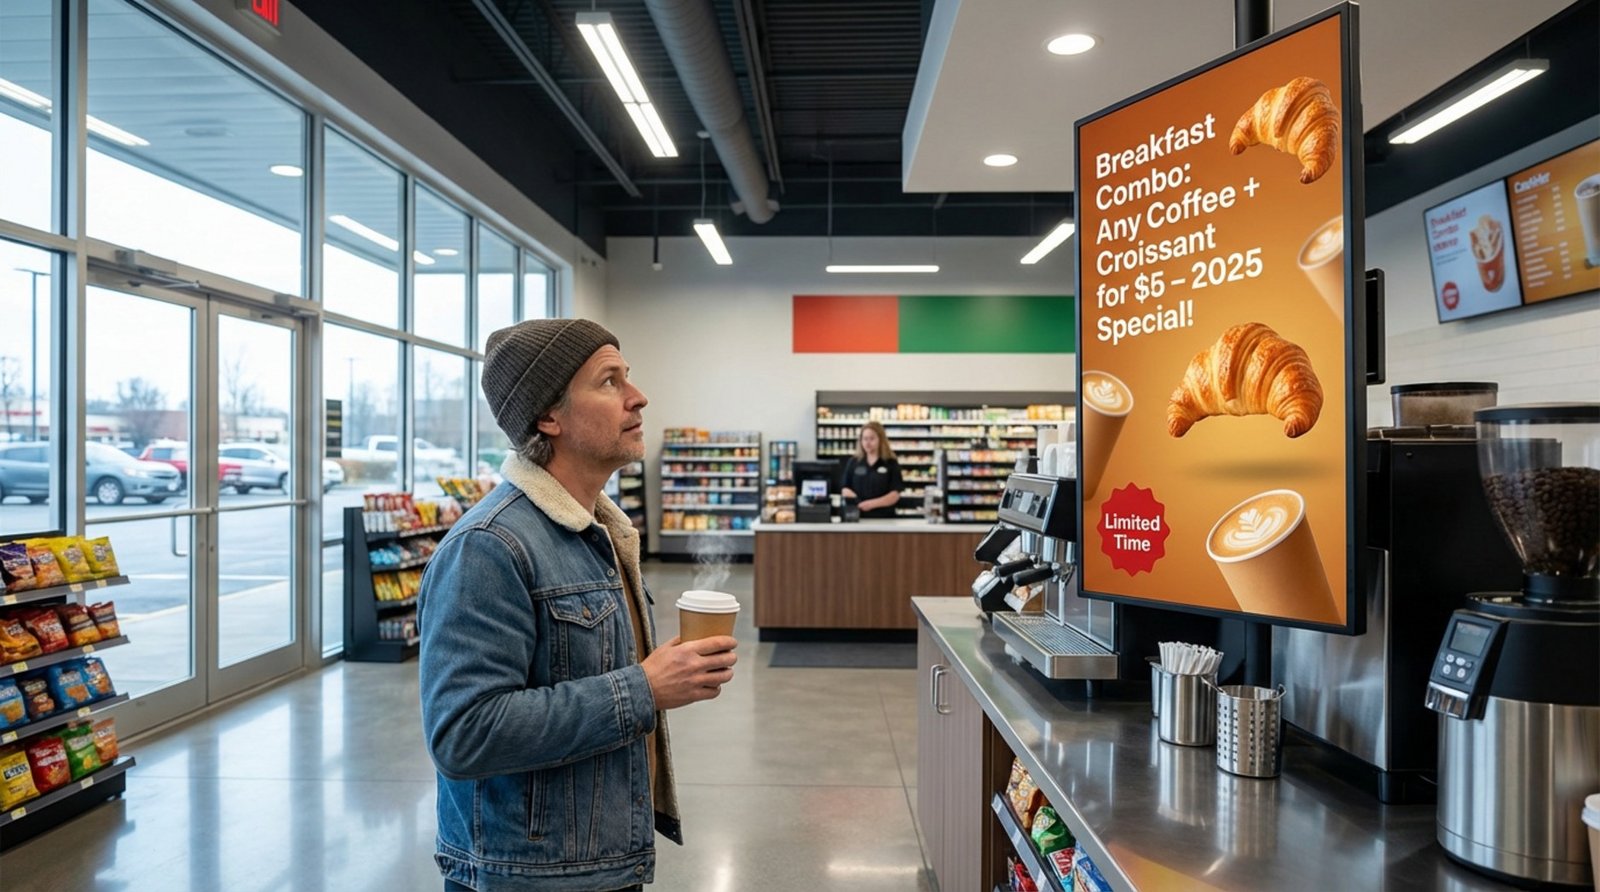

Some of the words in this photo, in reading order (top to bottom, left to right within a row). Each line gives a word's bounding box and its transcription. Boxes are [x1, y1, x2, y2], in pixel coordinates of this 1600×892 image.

[1096, 113, 1216, 179] Breakfast
[1096, 163, 1191, 210] Combo:
[1096, 213, 1142, 245] Any
[1146, 185, 1237, 229] Coffee
[1243, 176, 1260, 198] +
[1096, 223, 1217, 276] Croissant
[1096, 283, 1130, 309] for
[1134, 270, 1166, 304] $5
[1191, 247, 1264, 290] 2025
[1097, 299, 1194, 346] Special!
[1105, 513, 1160, 531] Limited
[1113, 534, 1151, 552] Time
